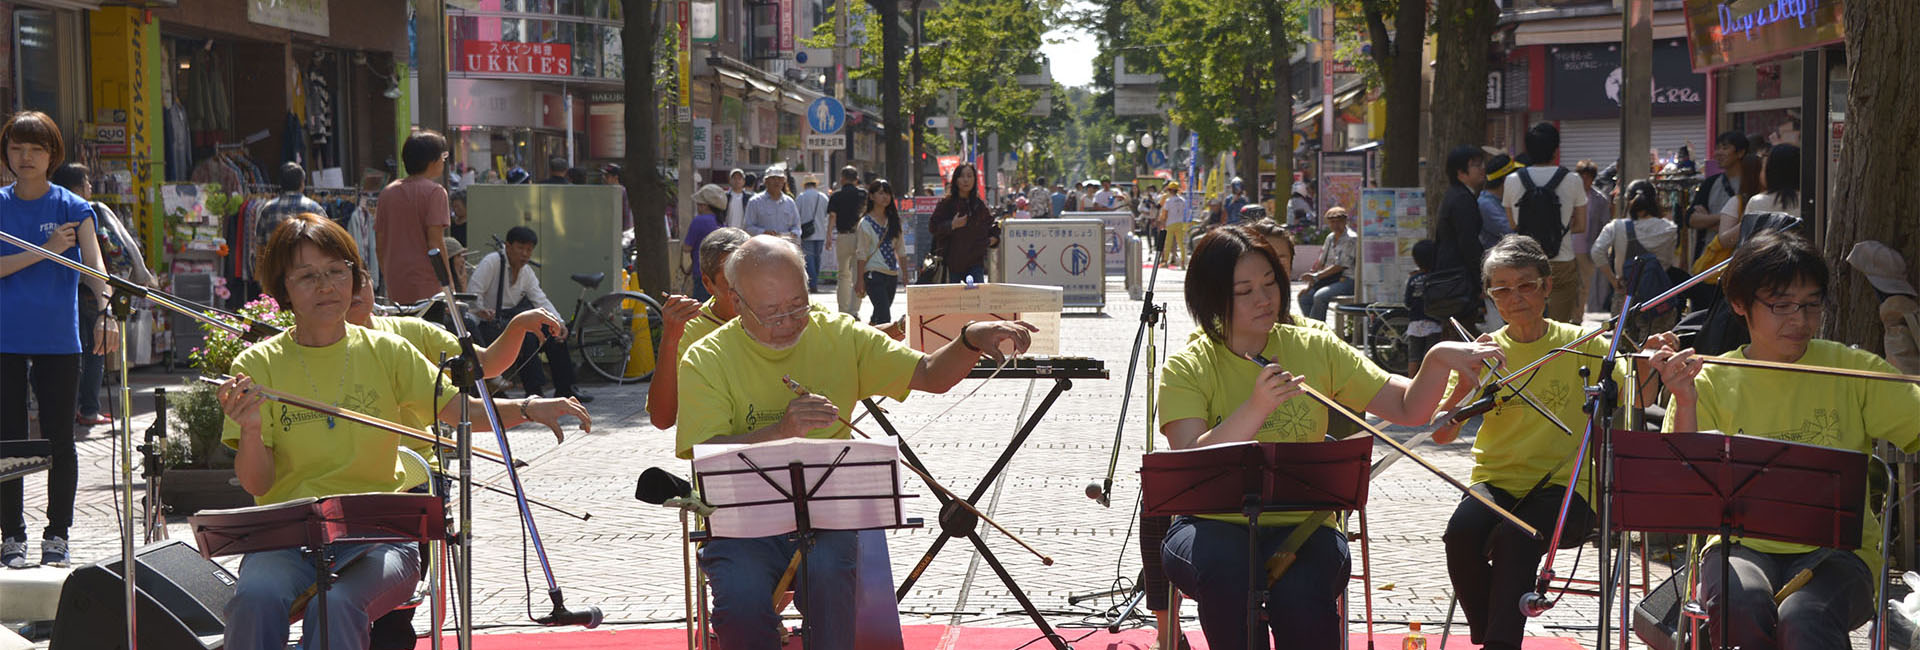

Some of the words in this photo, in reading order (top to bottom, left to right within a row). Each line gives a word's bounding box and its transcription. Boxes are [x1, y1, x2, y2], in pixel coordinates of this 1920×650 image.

[490, 43, 552, 56] スペイン料理
[467, 54, 568, 75] UKKIE'S
[98, 129, 124, 140] QUO
